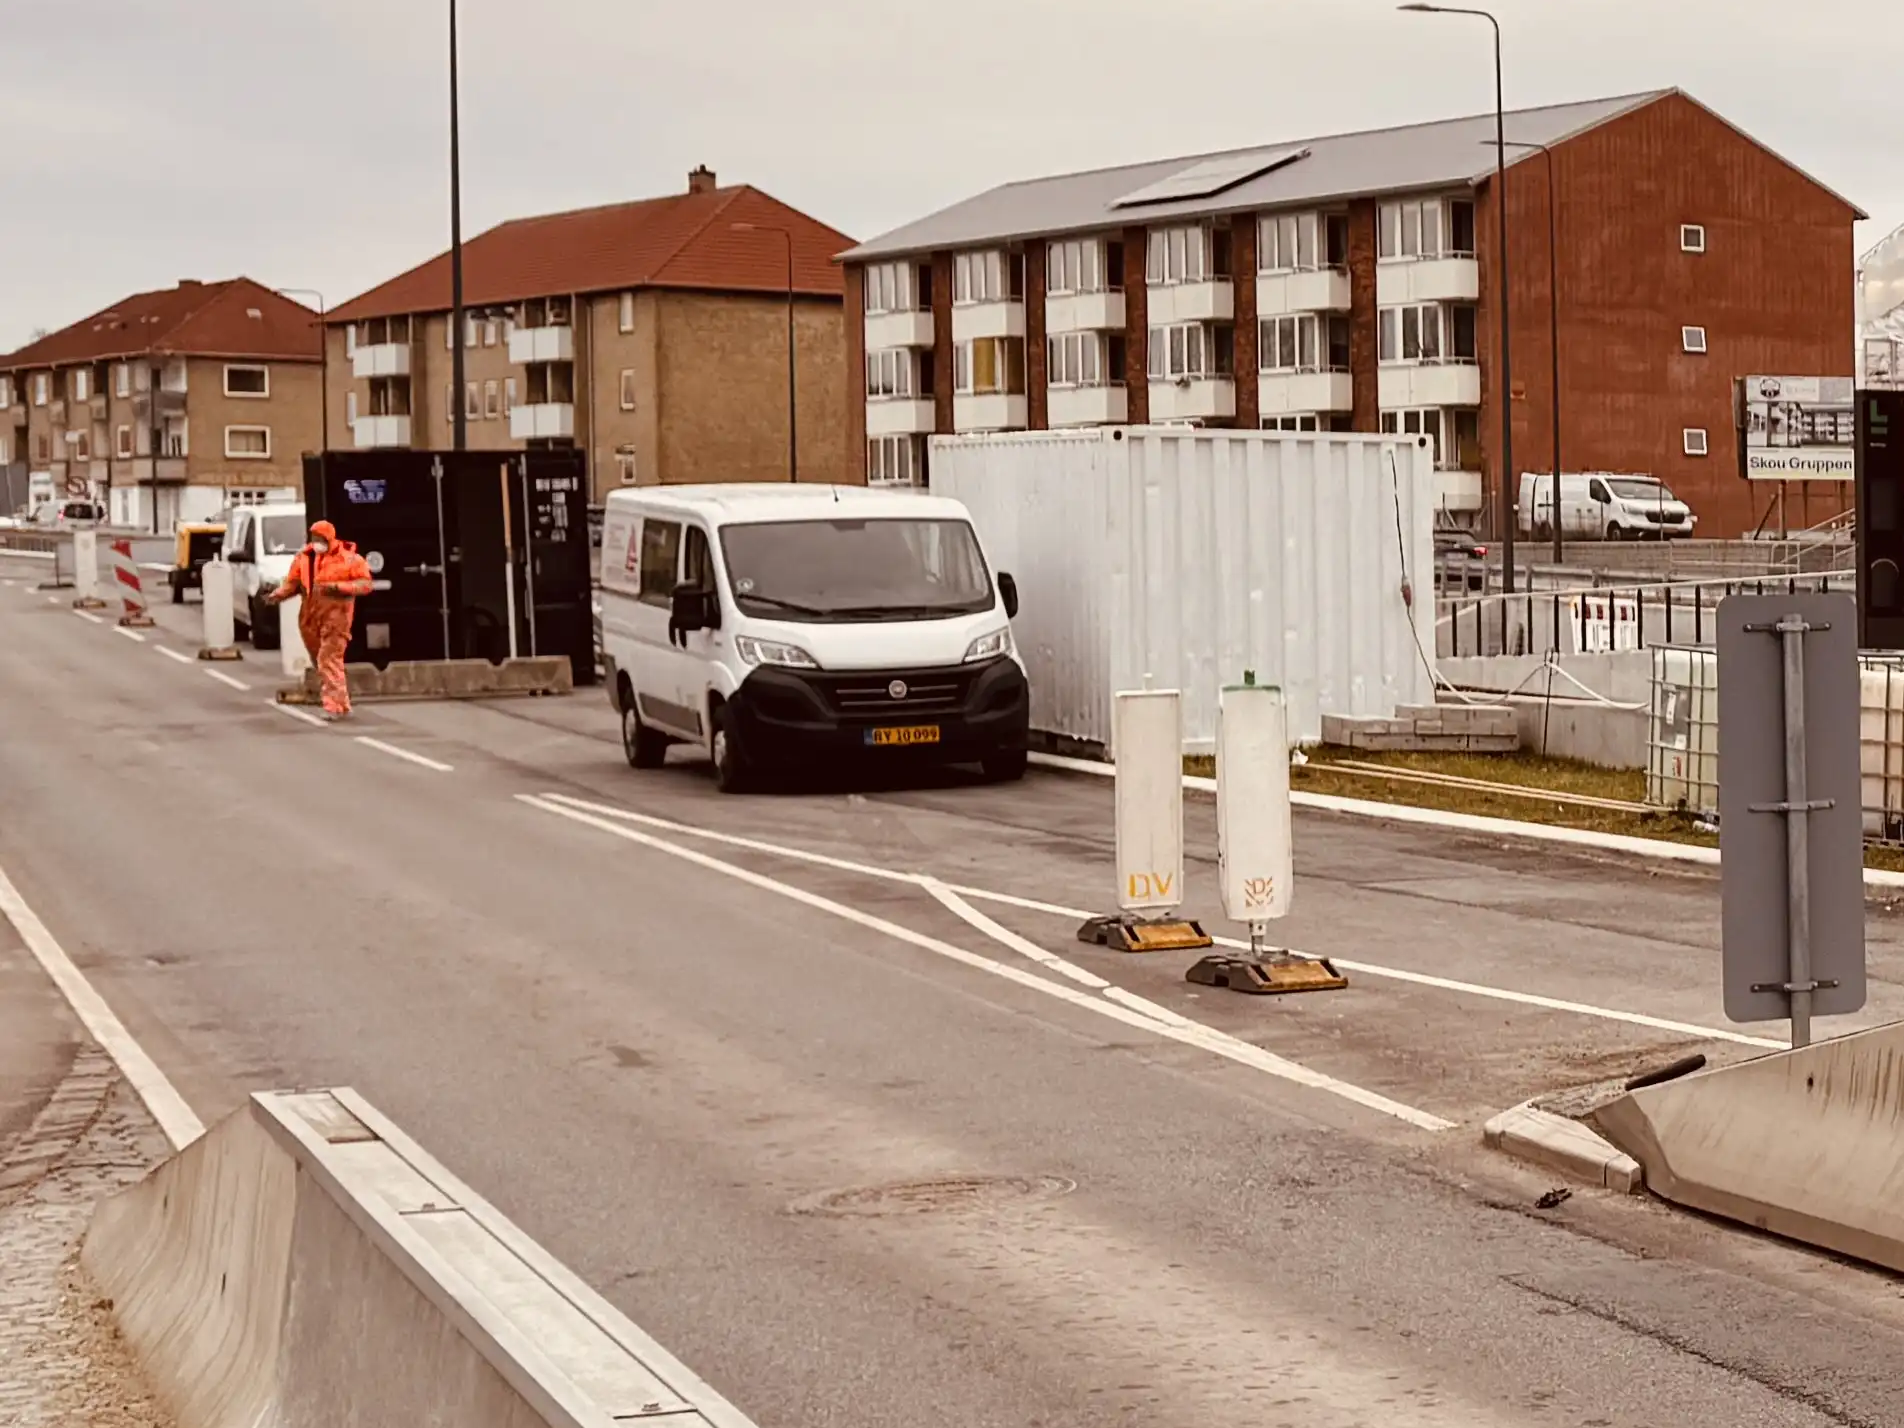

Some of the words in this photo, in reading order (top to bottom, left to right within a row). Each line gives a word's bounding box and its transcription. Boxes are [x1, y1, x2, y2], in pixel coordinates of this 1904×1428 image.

[1750, 456, 1786, 469] Skou
[1789, 457, 1852, 473] Gruppen
[1129, 873, 1173, 899] DV
